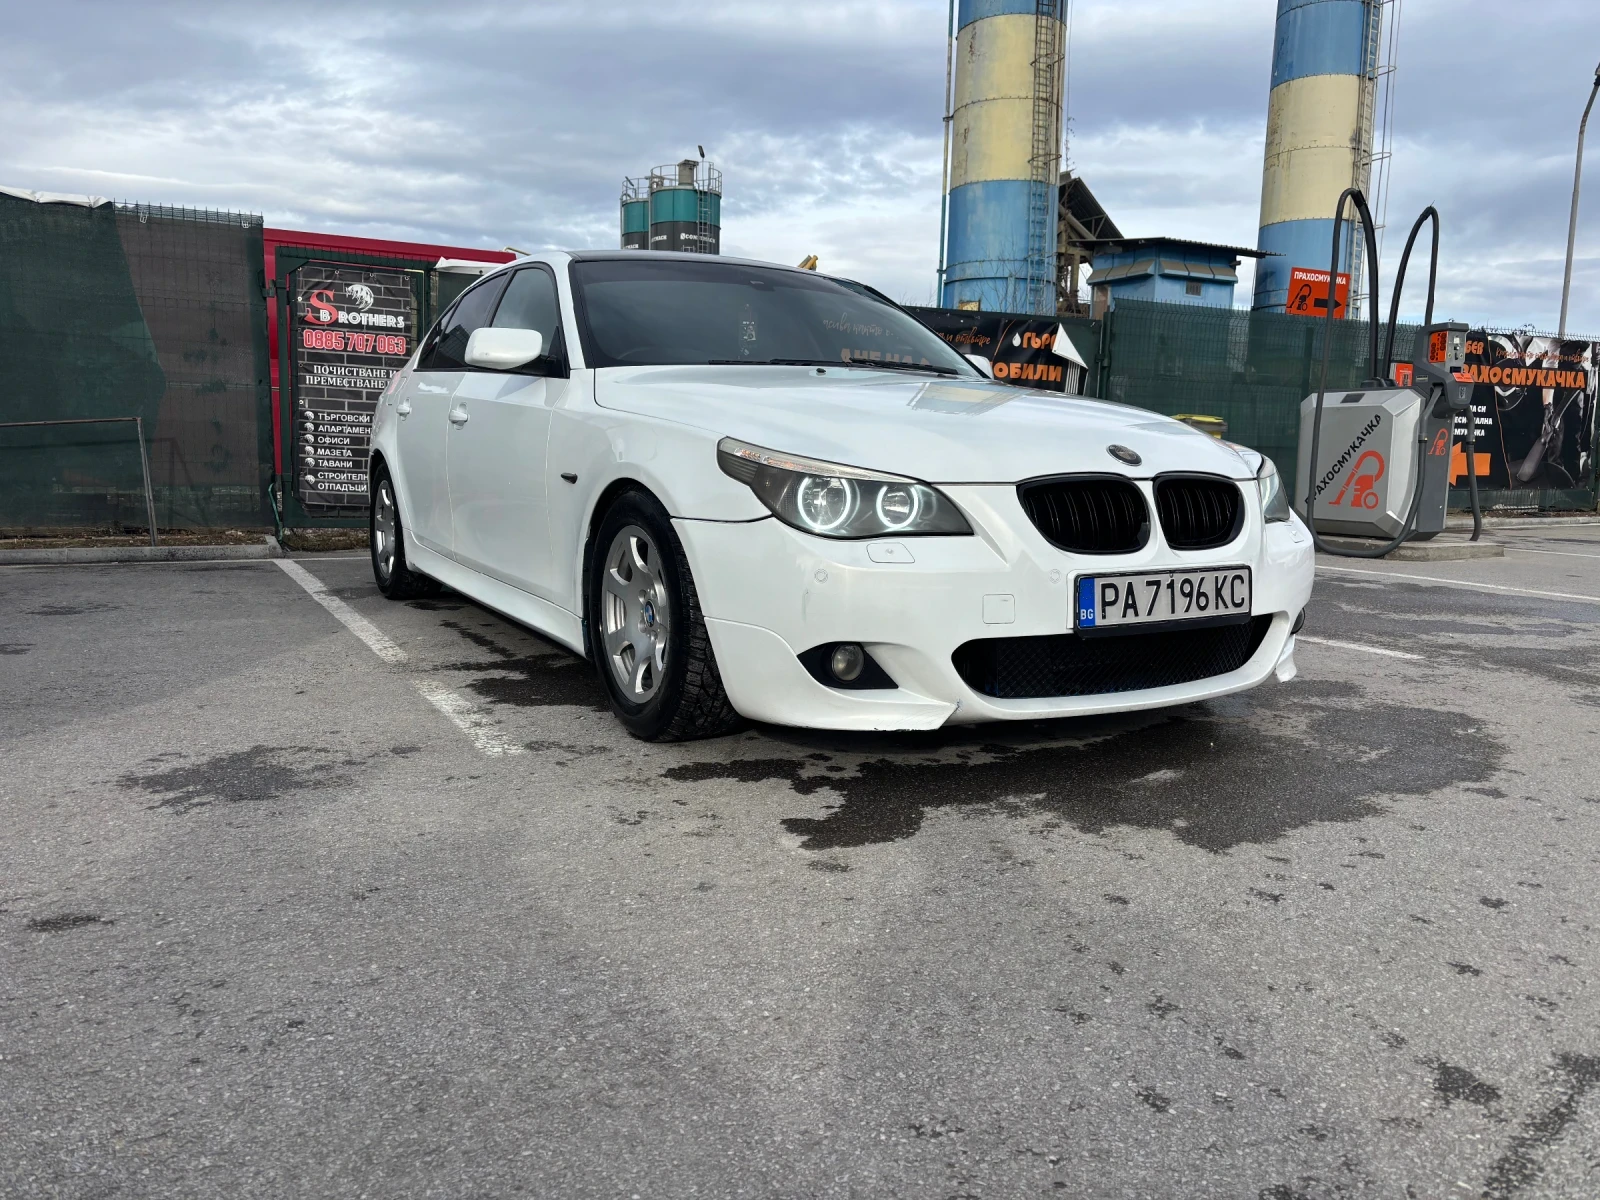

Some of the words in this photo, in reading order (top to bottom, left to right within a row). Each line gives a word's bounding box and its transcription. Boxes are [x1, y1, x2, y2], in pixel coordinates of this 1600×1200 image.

[1294, 271, 1347, 285] ПРАХОСМУКЧКА
[303, 329, 345, 351] 0885
[346, 332, 376, 353] 707
[376, 335, 406, 355] 063
[313, 365, 387, 378] ПОЧИСТВАНЕ
[989, 361, 1062, 382] ОБИЛИ
[305, 375, 385, 389] ПРЕМЕСТВАНЕ
[318, 413, 370, 422] ТЪРГОВСКИ
[318, 425, 372, 434] АПАРТАМЕН
[317, 436, 350, 444] ОФИСИ
[317, 448, 353, 457] МАЗЕТА
[318, 459, 353, 468] ТАВАНИ
[1304, 413, 1382, 506] АХОСМУКАЧКА
[317, 482, 367, 492] ОТПАДЪЦИ
[1080, 609, 1094, 620] BG
